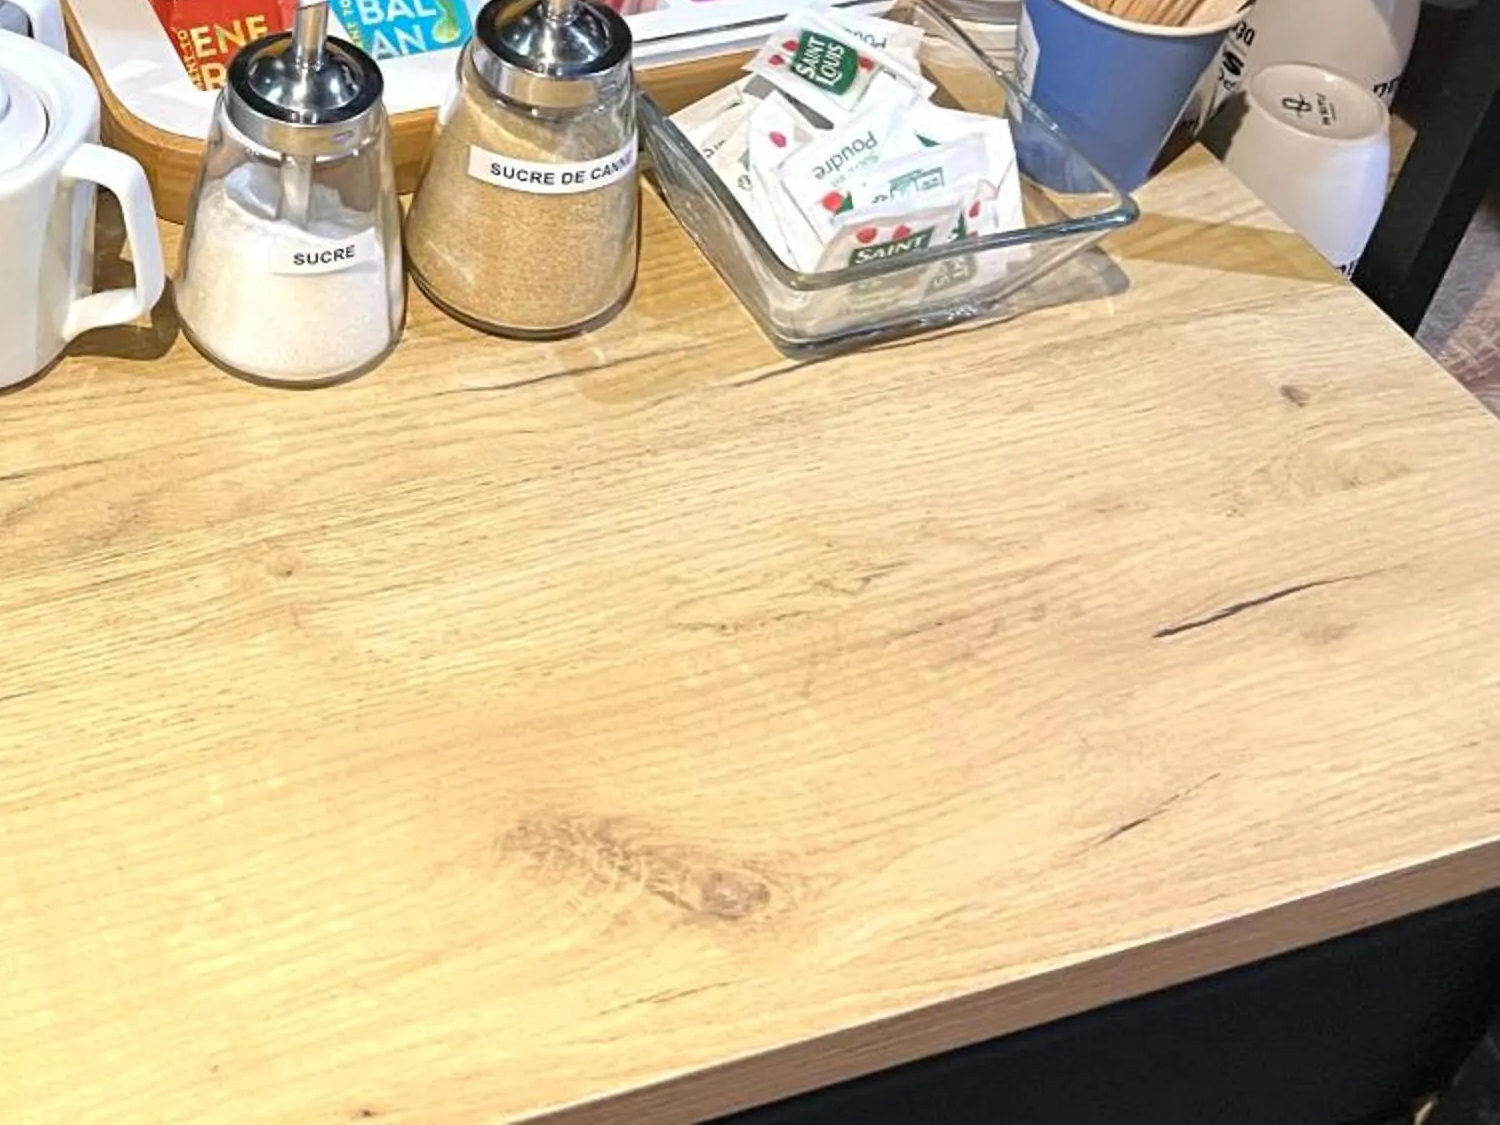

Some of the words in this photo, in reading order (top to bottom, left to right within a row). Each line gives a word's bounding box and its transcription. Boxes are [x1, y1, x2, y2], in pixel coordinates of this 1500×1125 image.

[371, 24, 428, 60] AN
[796, 36, 826, 79] SAINT
[815, 43, 845, 86] LOUIS
[812, 130, 878, 180] Poudre
[490, 162, 555, 185] SUCRE
[561, 170, 586, 185] DE
[293, 245, 356, 265] SUCRE
[855, 233, 927, 264] SAINT
